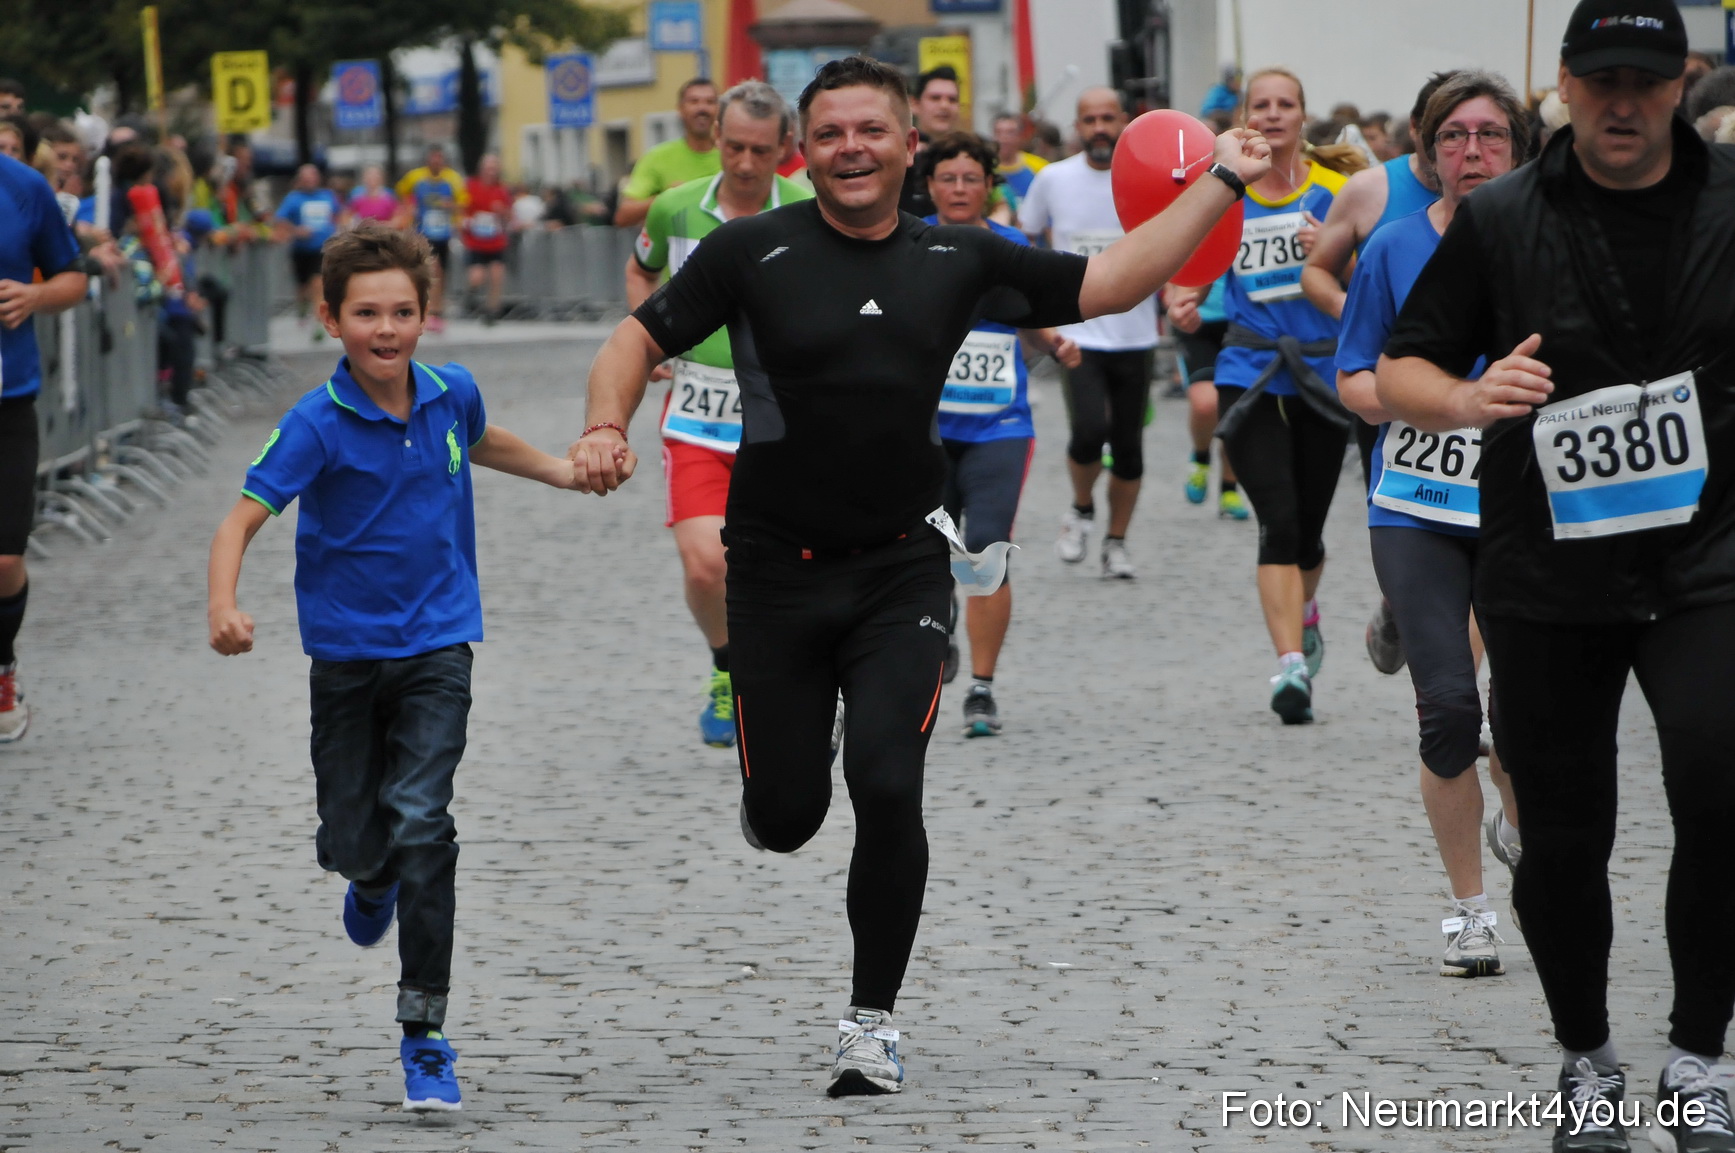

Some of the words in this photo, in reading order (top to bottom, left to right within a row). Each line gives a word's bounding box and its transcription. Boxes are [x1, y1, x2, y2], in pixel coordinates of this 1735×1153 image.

[1635, 15, 1664, 29] DTM
[229, 76, 256, 114] D
[1239, 233, 1307, 270] 2736
[946, 351, 1006, 382] 332
[1538, 407, 1589, 426] PARTL
[1592, 393, 1667, 417] Neumrkt
[1394, 426, 1482, 481] 2267
[1553, 411, 1690, 483] 3380
[1414, 483, 1450, 505] Anni
